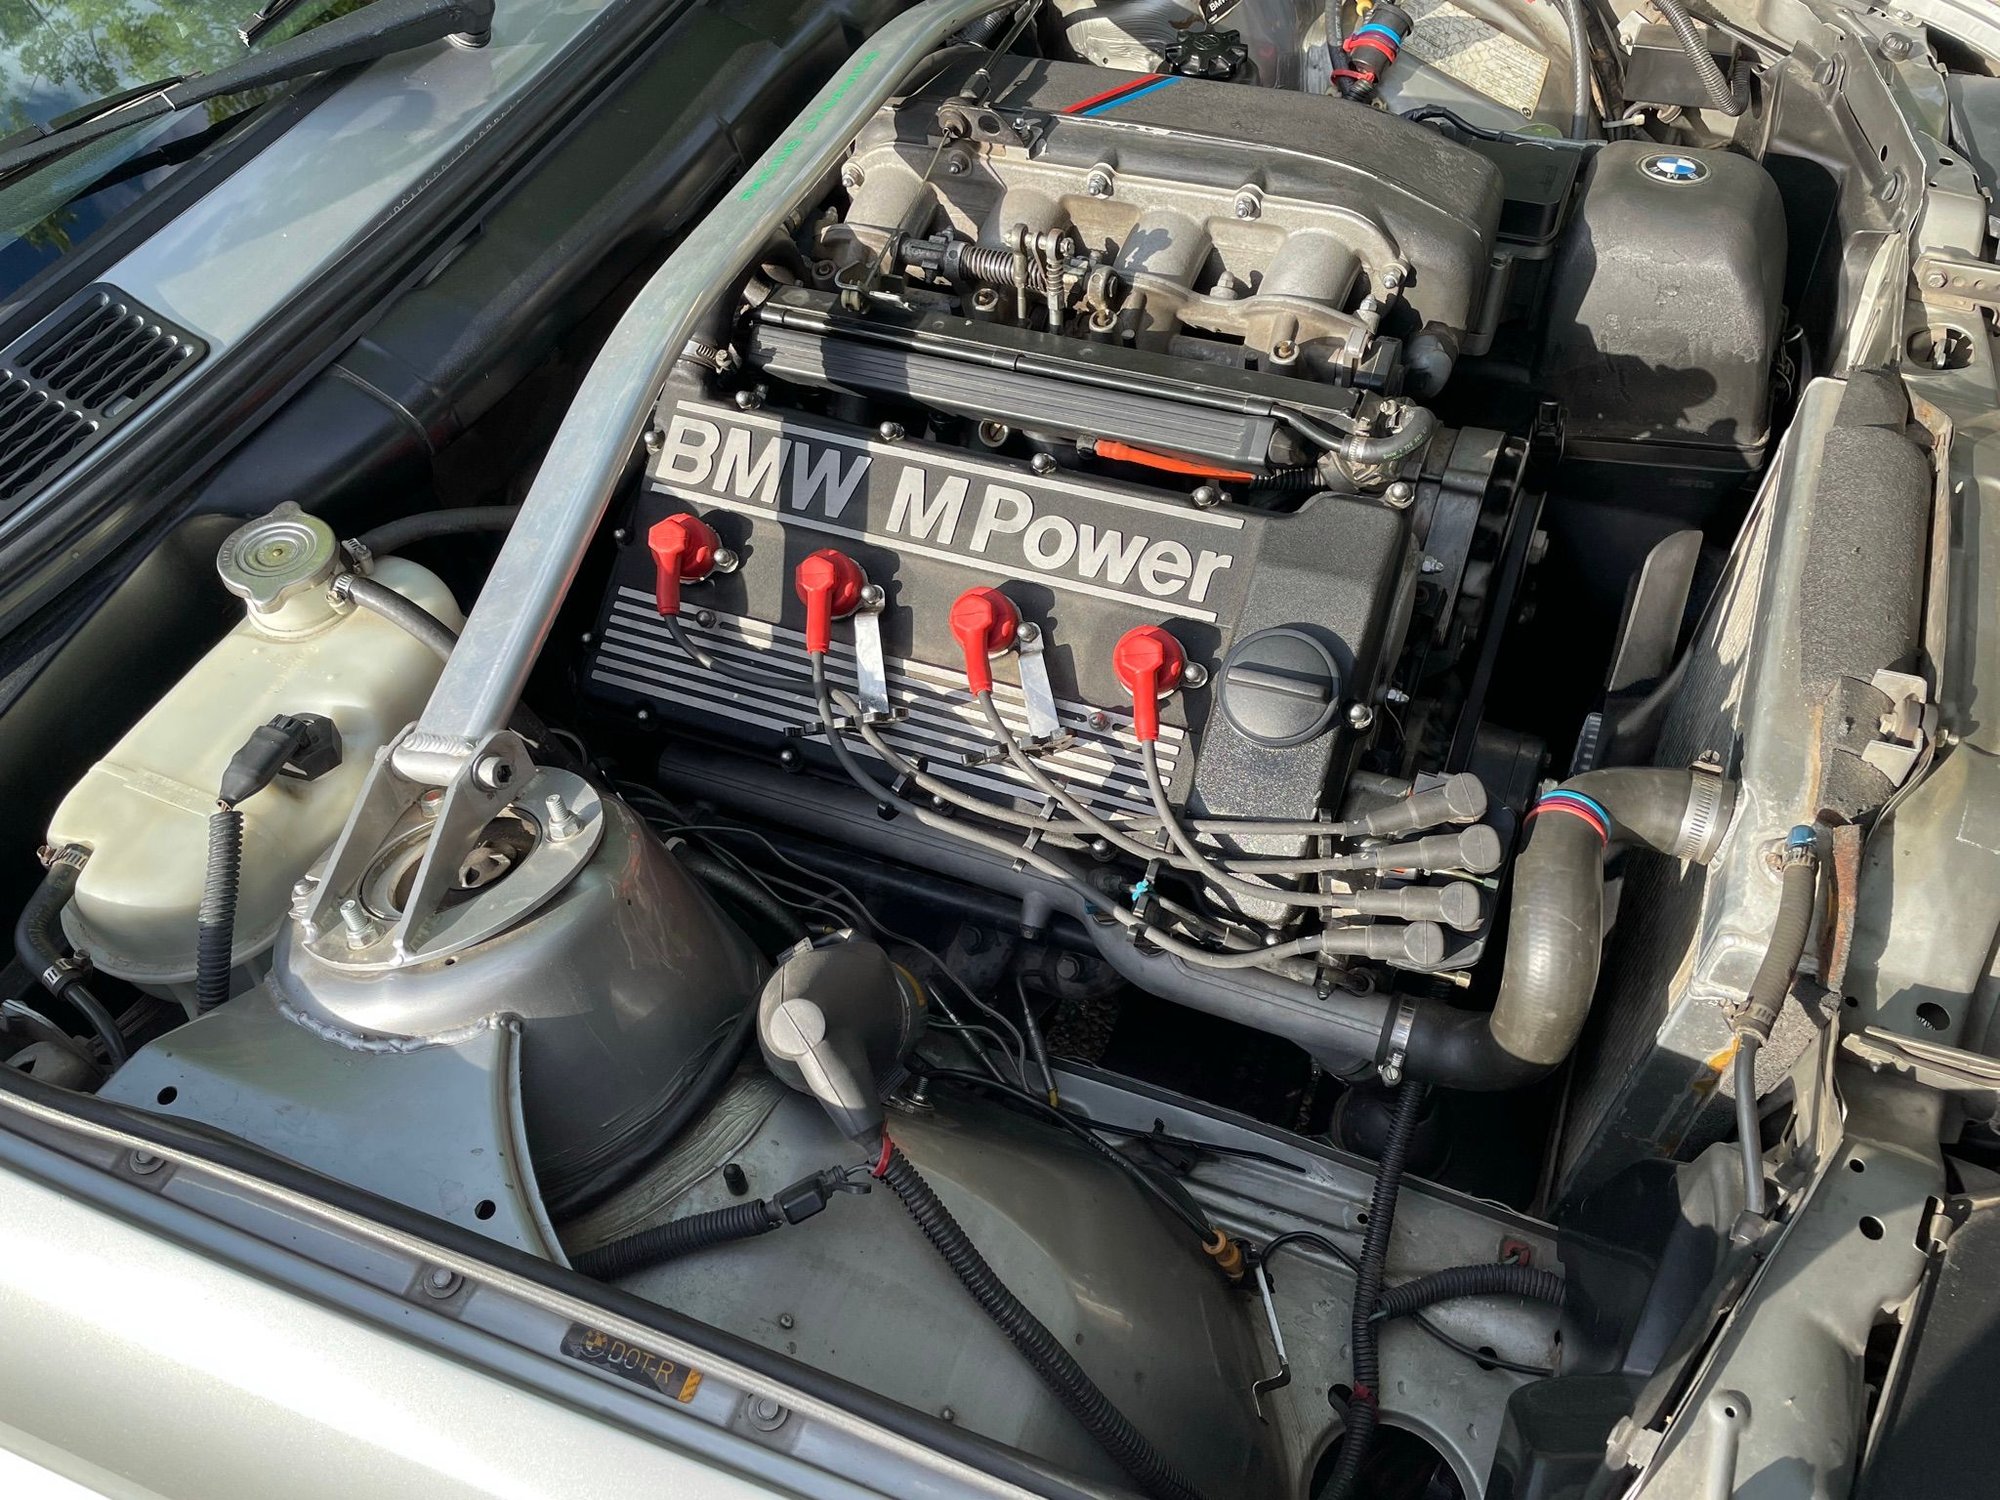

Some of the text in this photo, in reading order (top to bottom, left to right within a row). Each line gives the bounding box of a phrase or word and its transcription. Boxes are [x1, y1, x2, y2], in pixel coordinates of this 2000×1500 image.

[655, 415, 1233, 602] BMW M Power
[607, 1341, 676, 1384] DOT-R
